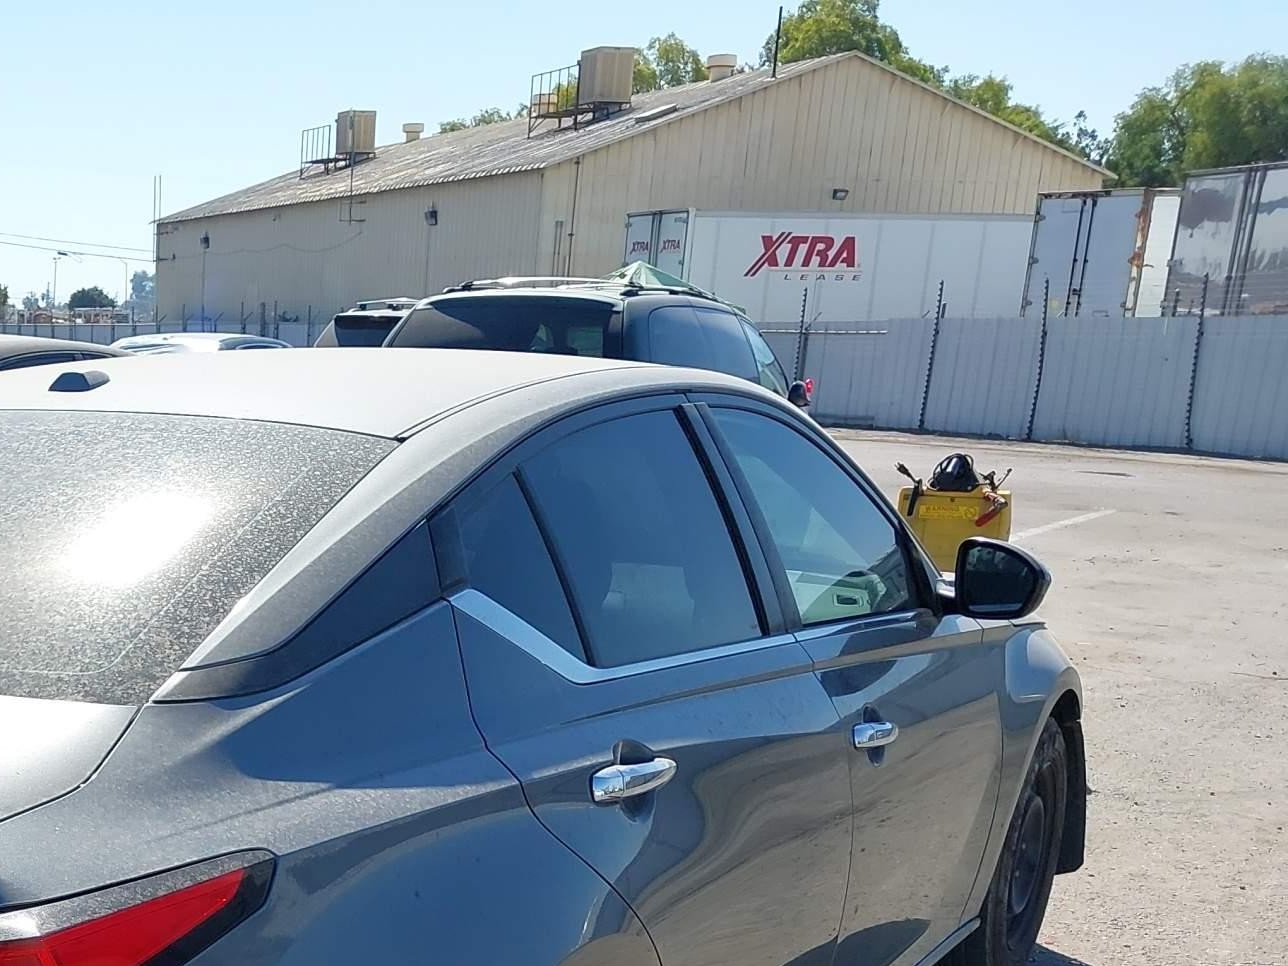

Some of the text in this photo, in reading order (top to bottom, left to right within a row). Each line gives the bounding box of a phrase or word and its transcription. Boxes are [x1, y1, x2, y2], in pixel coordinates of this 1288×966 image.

[629, 240, 649, 255] XTRA
[660, 238, 681, 253] XTRA
[743, 232, 856, 277] XTRA
[924, 504, 960, 512] WARNG
